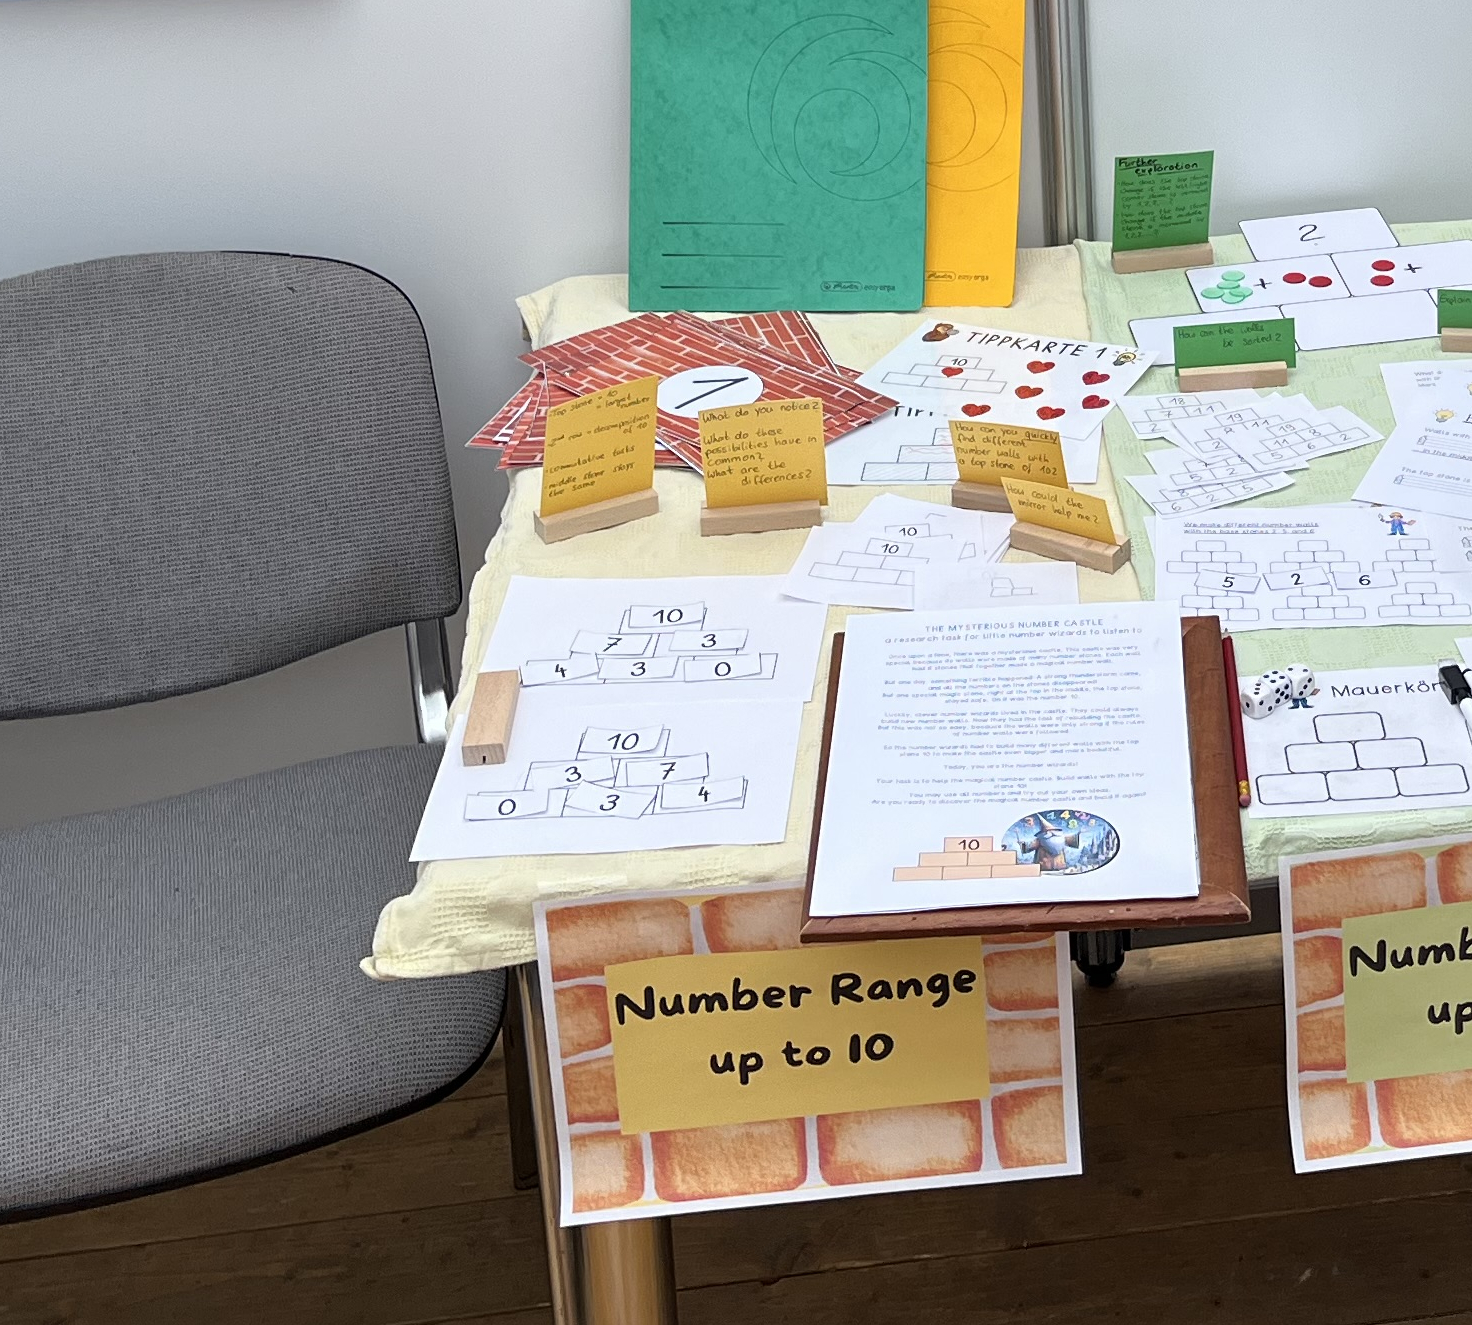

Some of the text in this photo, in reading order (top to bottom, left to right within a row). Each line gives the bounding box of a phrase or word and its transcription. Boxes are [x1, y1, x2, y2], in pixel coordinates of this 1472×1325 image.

[1119, 158, 1157, 167] Further
[1135, 162, 1198, 175] exploration
[1299, 224, 1324, 243] 2
[967, 331, 1107, 358] TIPPKARTE 1
[703, 411, 729, 423] What
[735, 408, 749, 417] do
[755, 407, 773, 416] you
[703, 431, 729, 445] What
[735, 431, 749, 439] do
[955, 423, 973, 432] How
[1001, 428, 1017, 436] you
[1025, 431, 1059, 443] quickly
[958, 434, 1027, 447] find different
[705, 442, 768, 459] possibilities
[956, 446, 1049, 462] number walls with
[707, 466, 733, 478] What
[768, 461, 786, 470] the
[1222, 574, 1370, 588] 5 2 6
[653, 609, 683, 623] 10
[603, 634, 716, 652] 7 3
[555, 662, 646, 678] 4 3
[608, 733, 639, 751] 10
[957, 839, 979, 850] 10
[615, 969, 977, 1025] Number Range
[710, 1033, 894, 1085] up to 10
